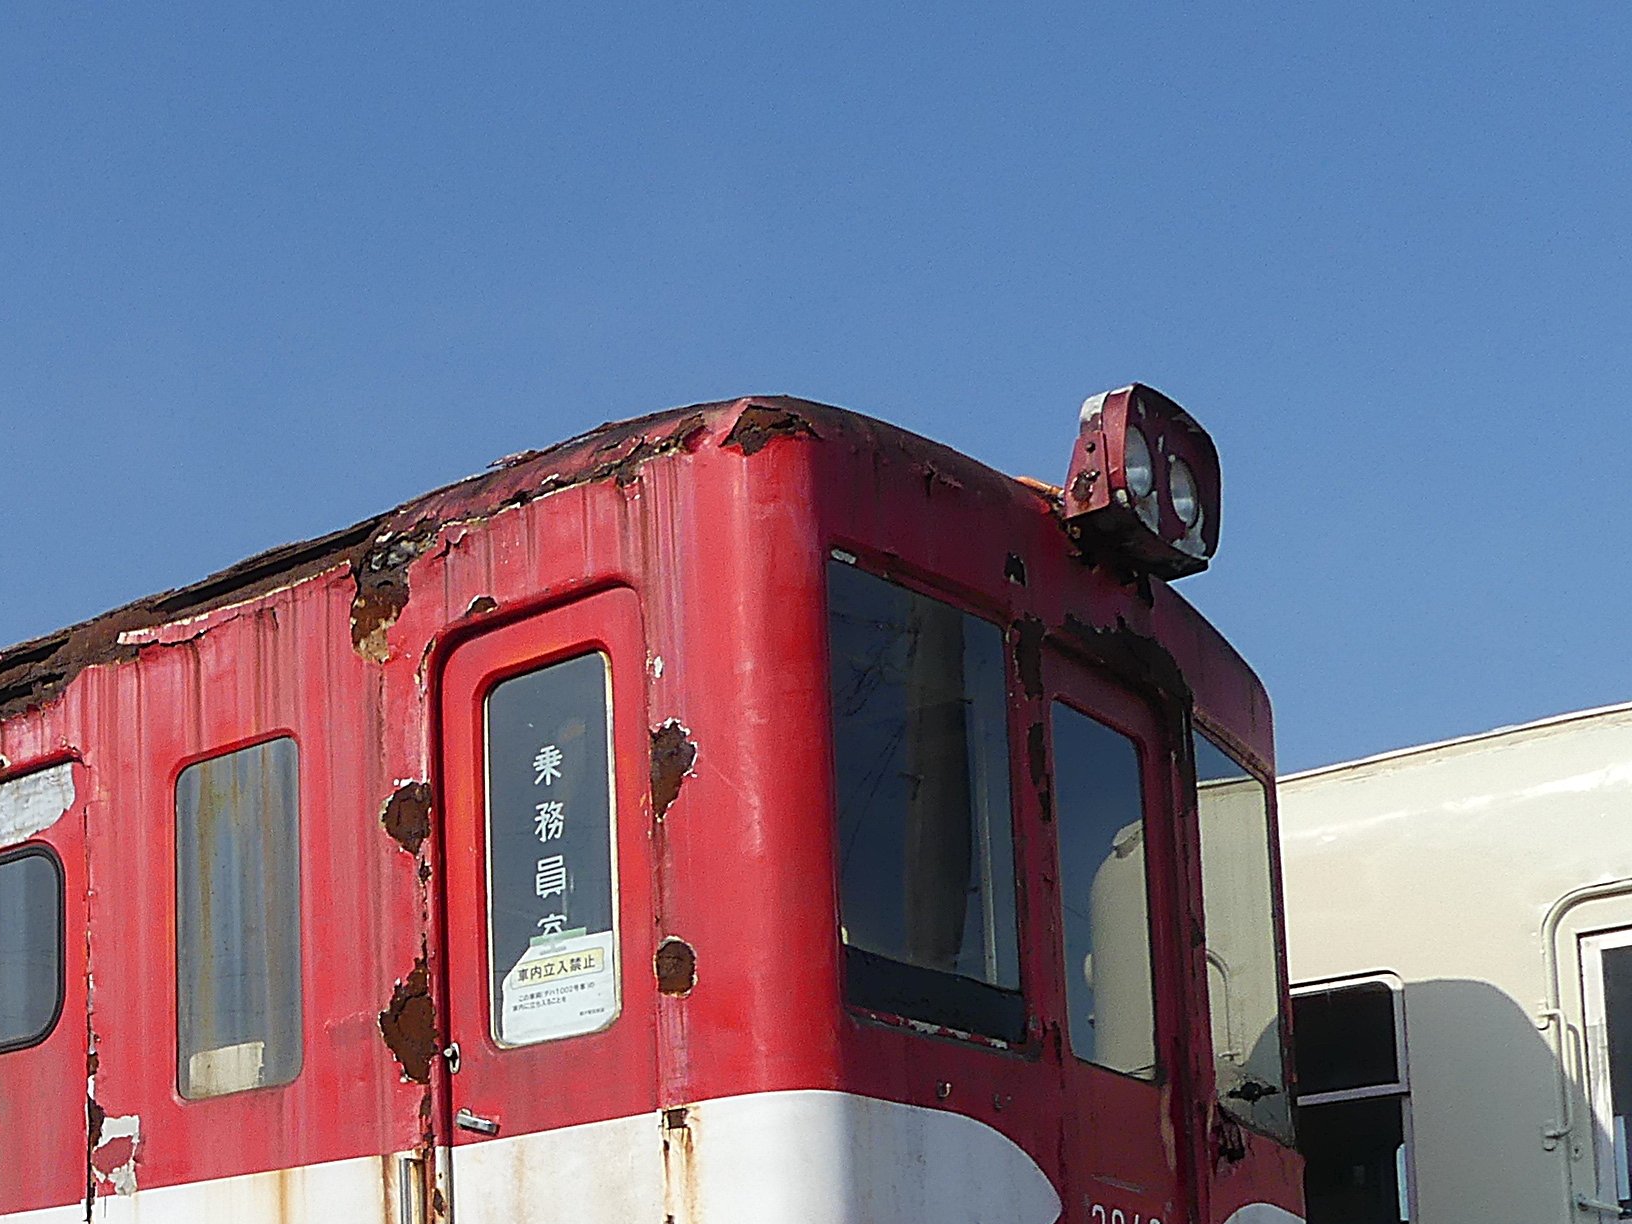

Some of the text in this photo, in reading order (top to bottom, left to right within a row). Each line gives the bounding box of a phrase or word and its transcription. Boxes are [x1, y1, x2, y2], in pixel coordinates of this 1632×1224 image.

[518, 954, 595, 982] 車内立入禁止
